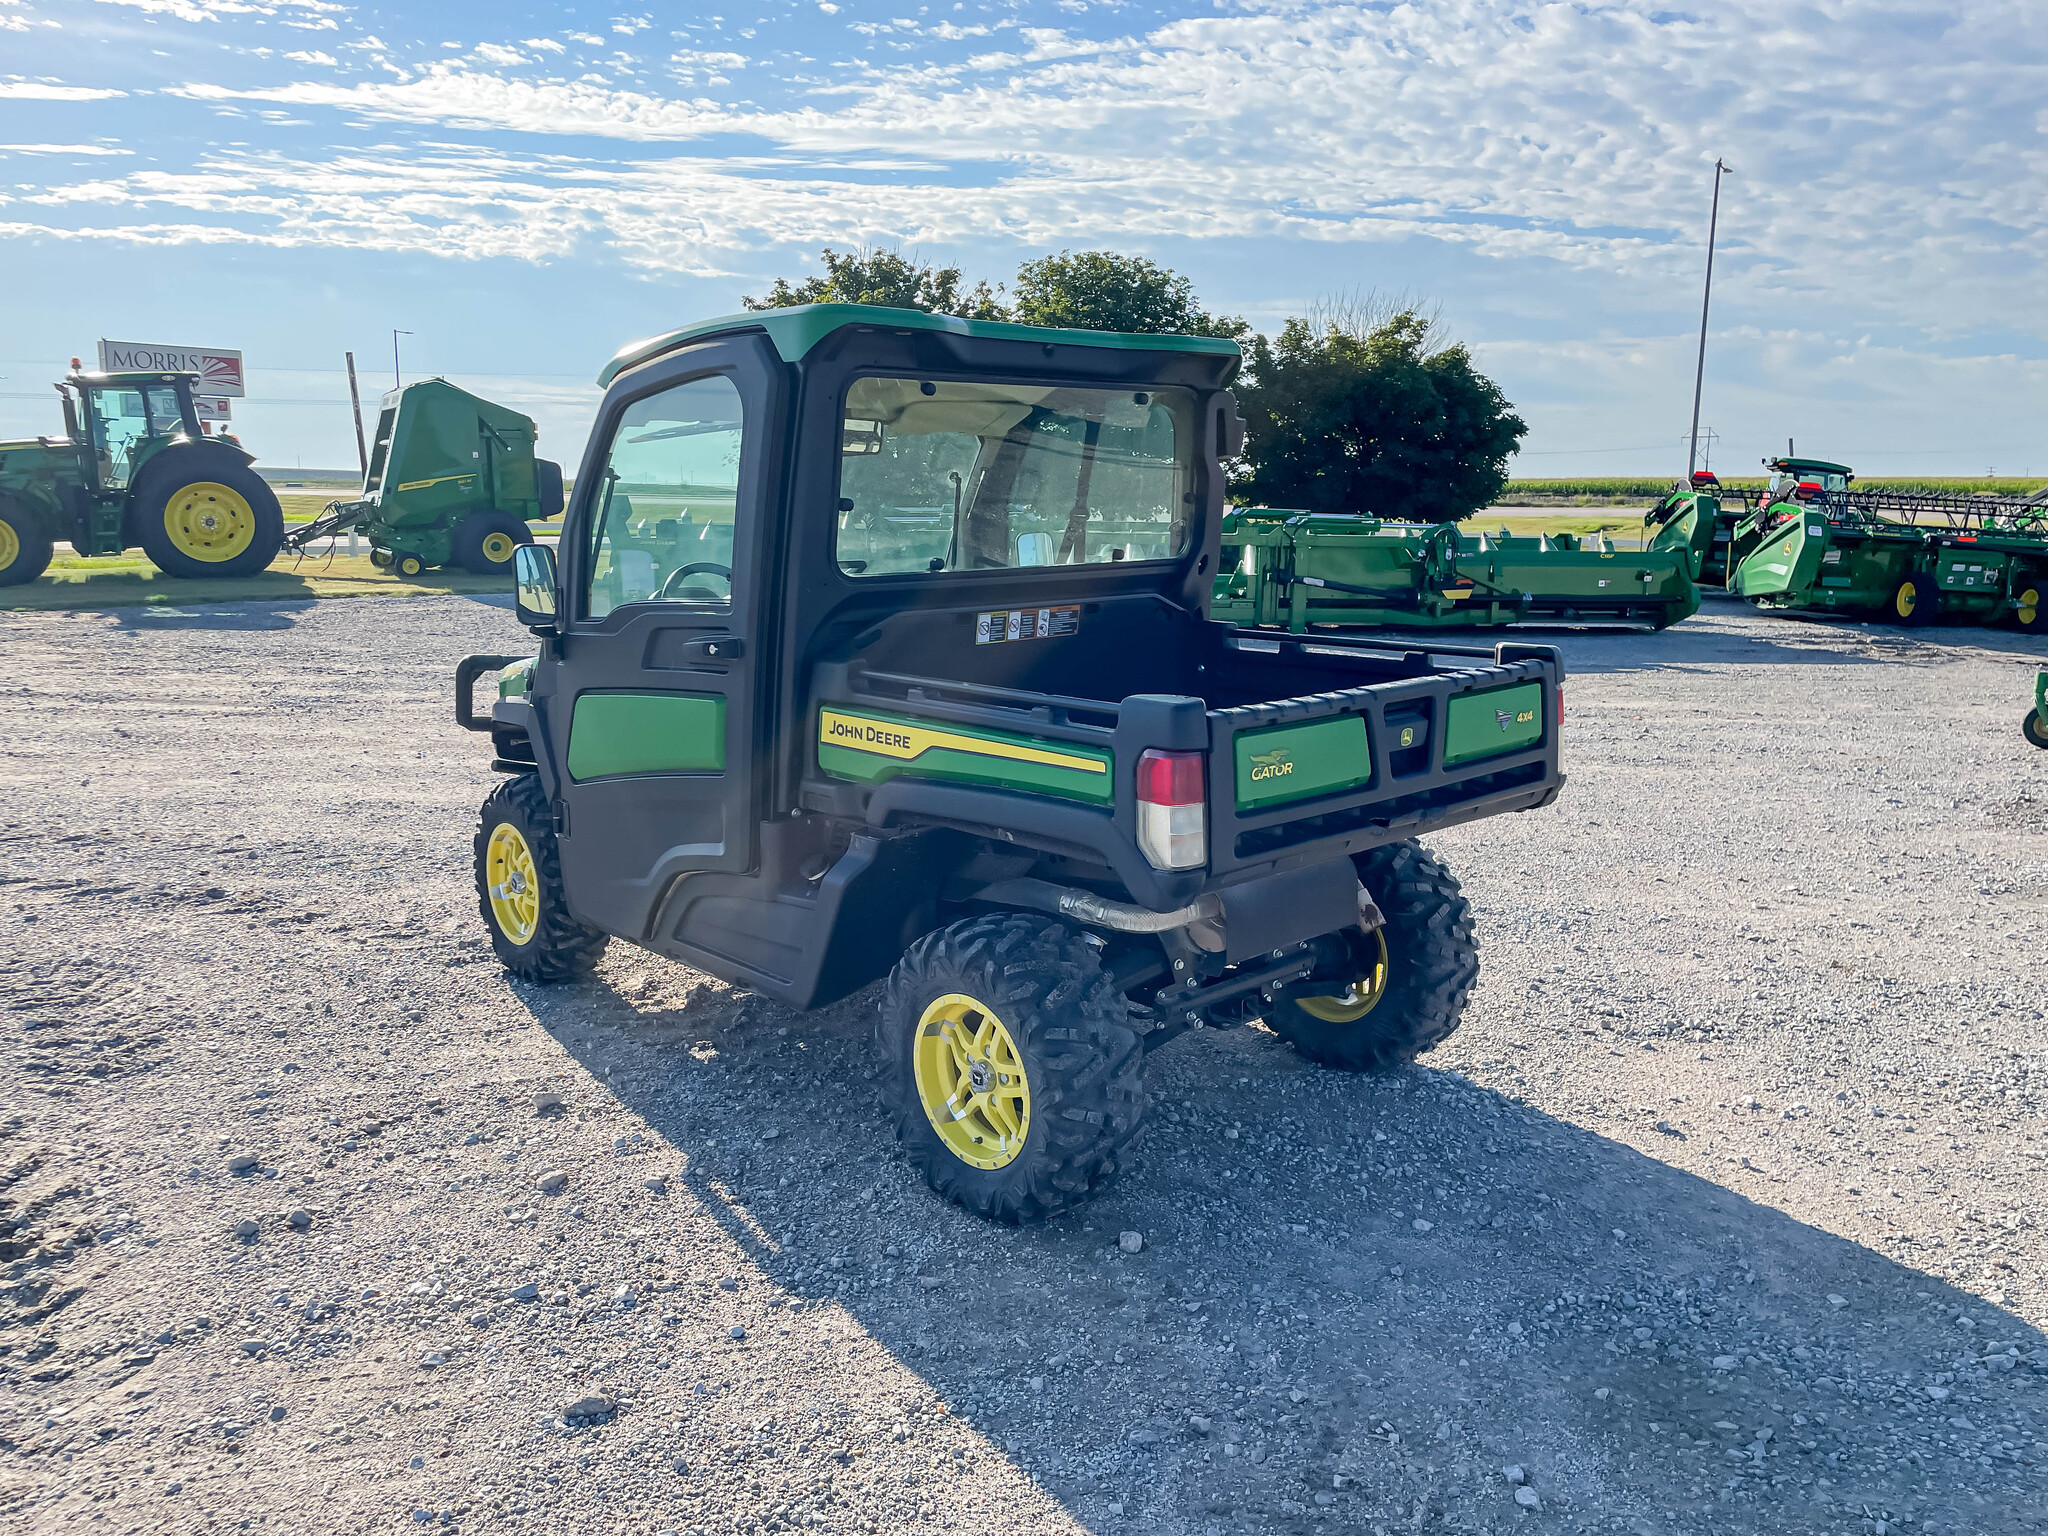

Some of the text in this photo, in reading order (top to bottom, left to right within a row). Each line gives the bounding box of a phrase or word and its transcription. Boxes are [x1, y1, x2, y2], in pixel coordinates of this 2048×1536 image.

[112, 349, 199, 371] MORRIS
[828, 720, 911, 750] JOHN DEERE
[1251, 762, 1294, 781] GATOR
